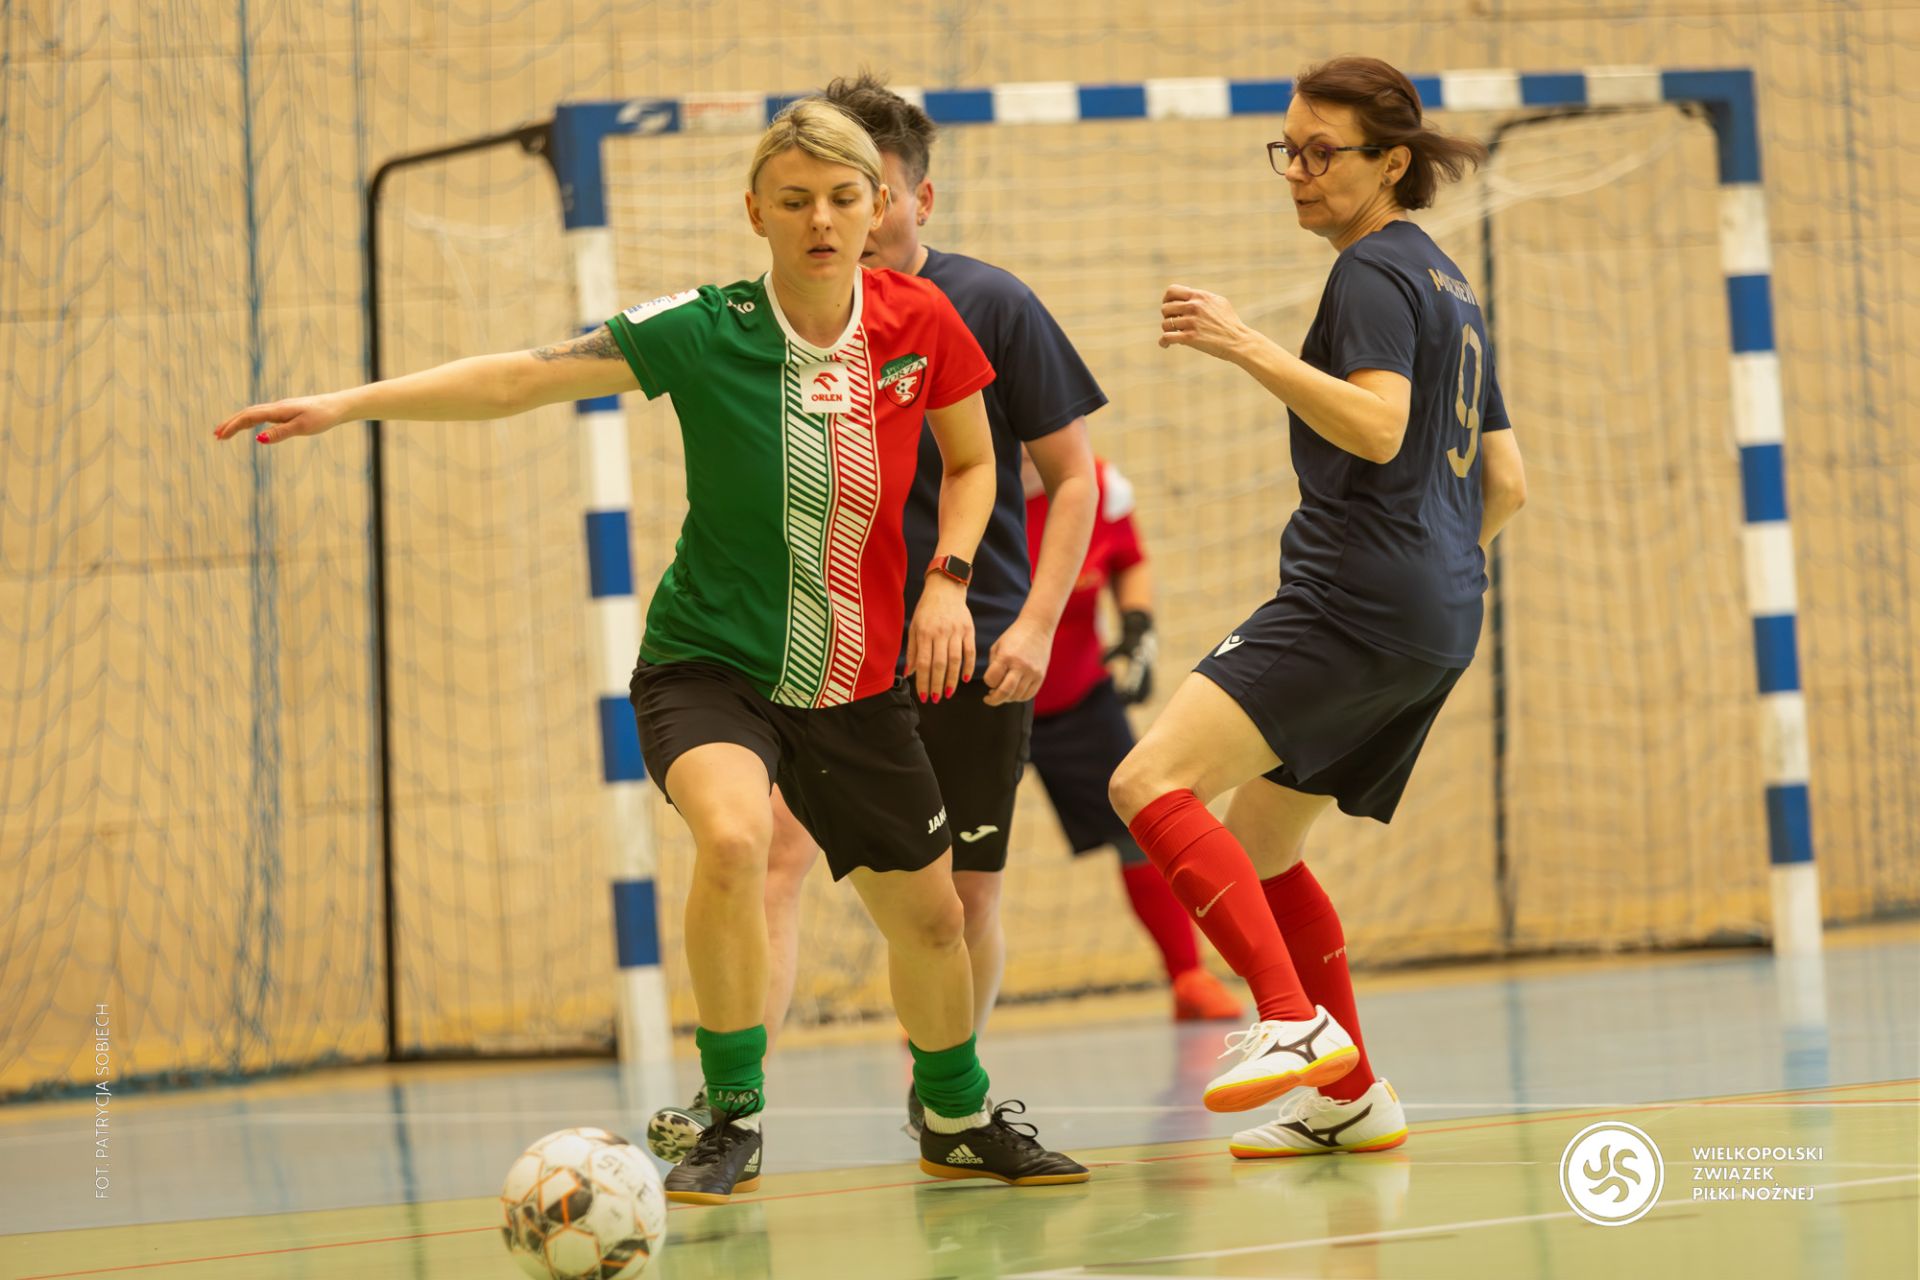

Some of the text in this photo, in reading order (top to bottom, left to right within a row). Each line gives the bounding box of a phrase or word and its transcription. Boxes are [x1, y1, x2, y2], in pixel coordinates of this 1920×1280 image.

[811, 393, 843, 402] ORLEN
[1446, 322, 1483, 479] 9
[928, 805, 947, 834] JAK
[715, 1088, 759, 1103] JAK
[945, 1157, 984, 1165] adidas
